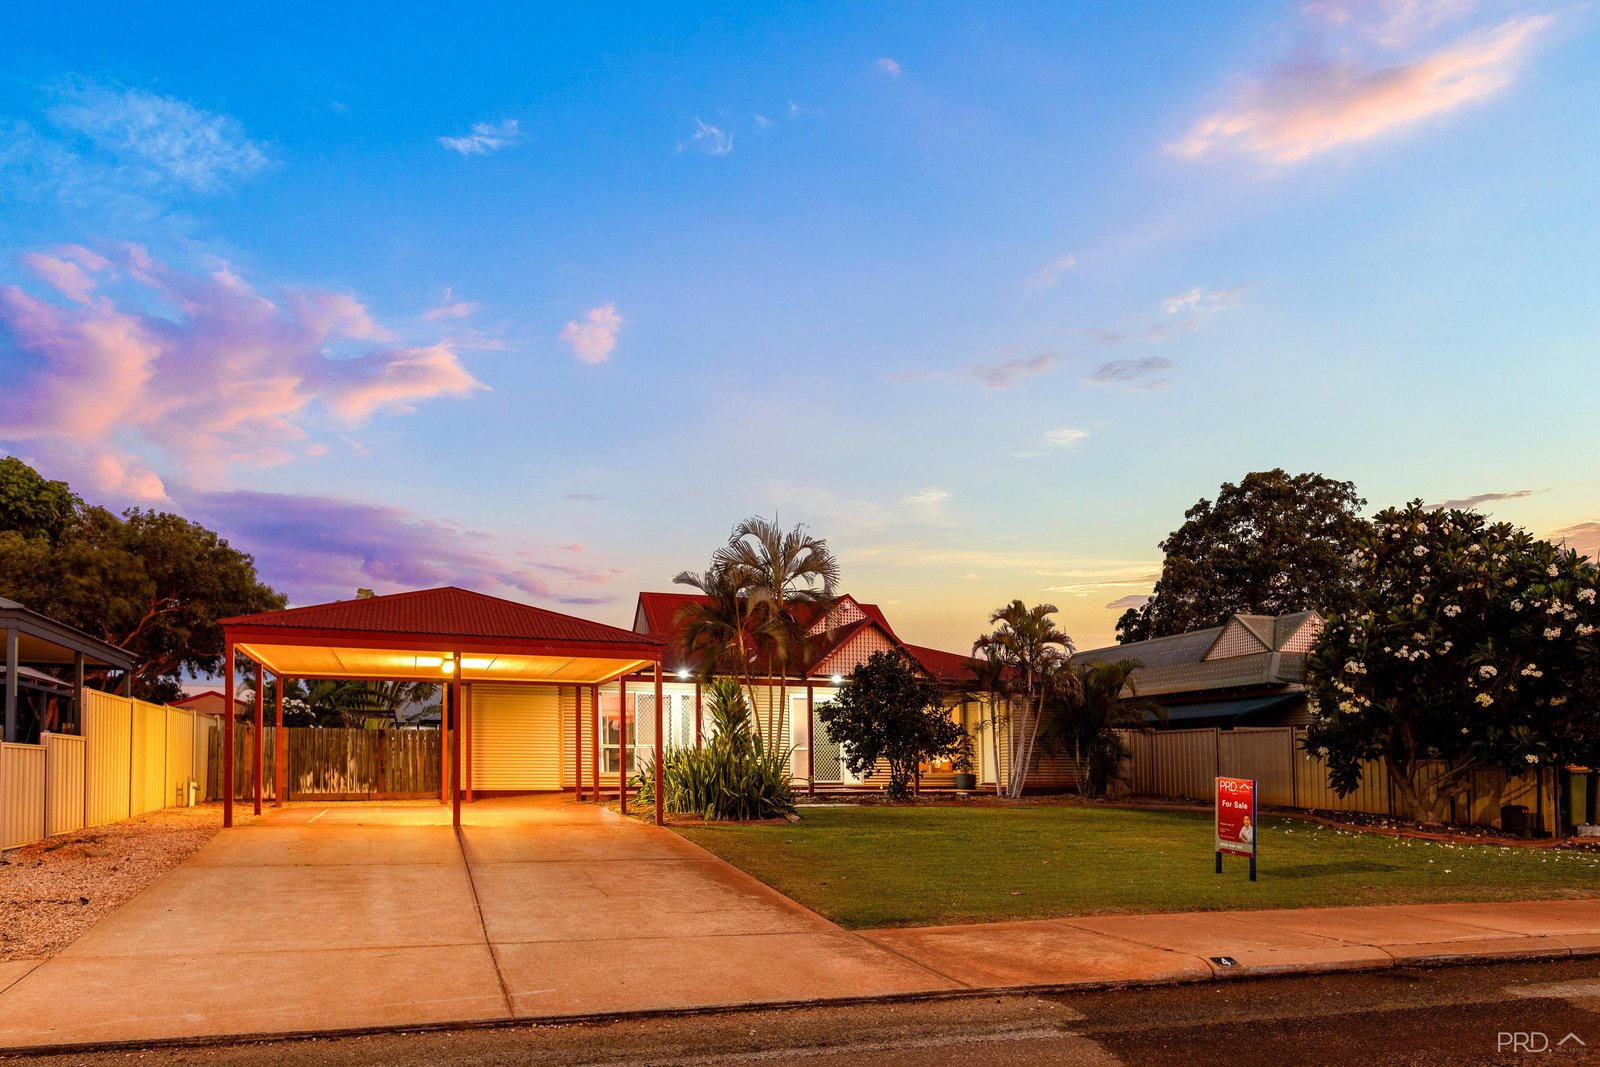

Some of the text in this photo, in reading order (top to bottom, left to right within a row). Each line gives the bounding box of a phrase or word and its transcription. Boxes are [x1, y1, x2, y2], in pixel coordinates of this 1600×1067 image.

[1222, 799, 1248, 810] For Sale
[1220, 957, 1231, 966] 4
